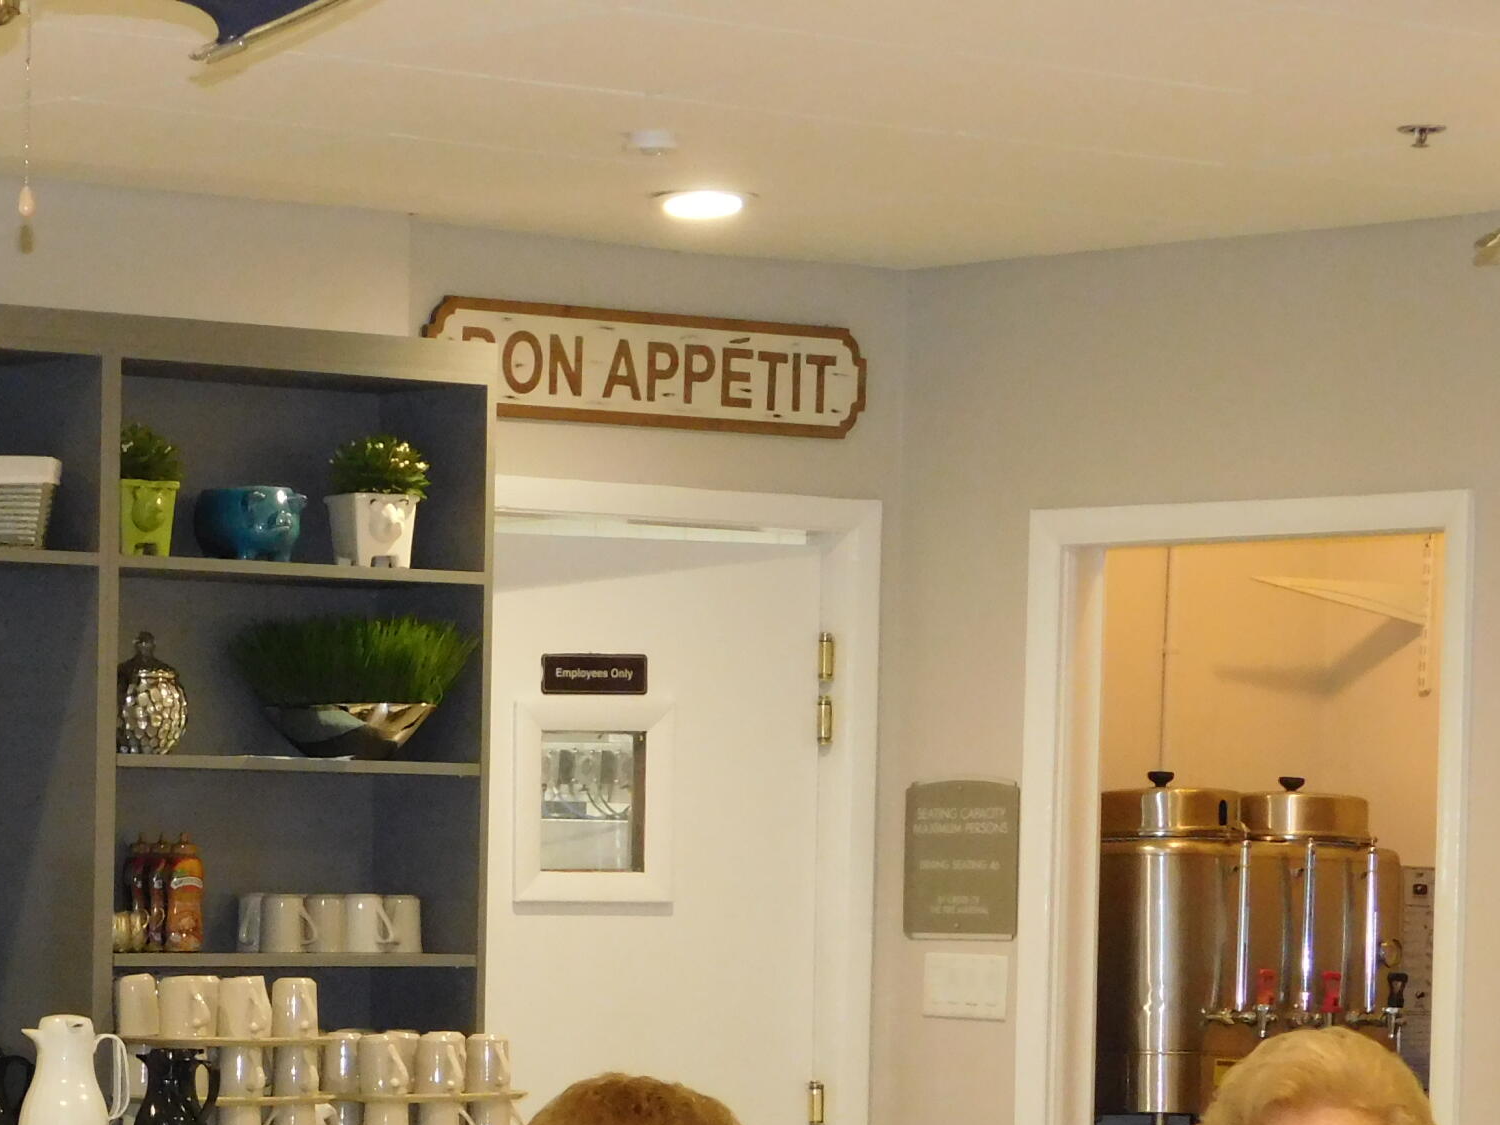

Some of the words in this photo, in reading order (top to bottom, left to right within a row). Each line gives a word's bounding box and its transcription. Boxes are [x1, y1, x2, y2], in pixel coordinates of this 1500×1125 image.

[462, 326, 583, 396] ON
[602, 337, 837, 414] APPÉTIT
[556, 667, 608, 680] Employees
[610, 668, 633, 680] Only
